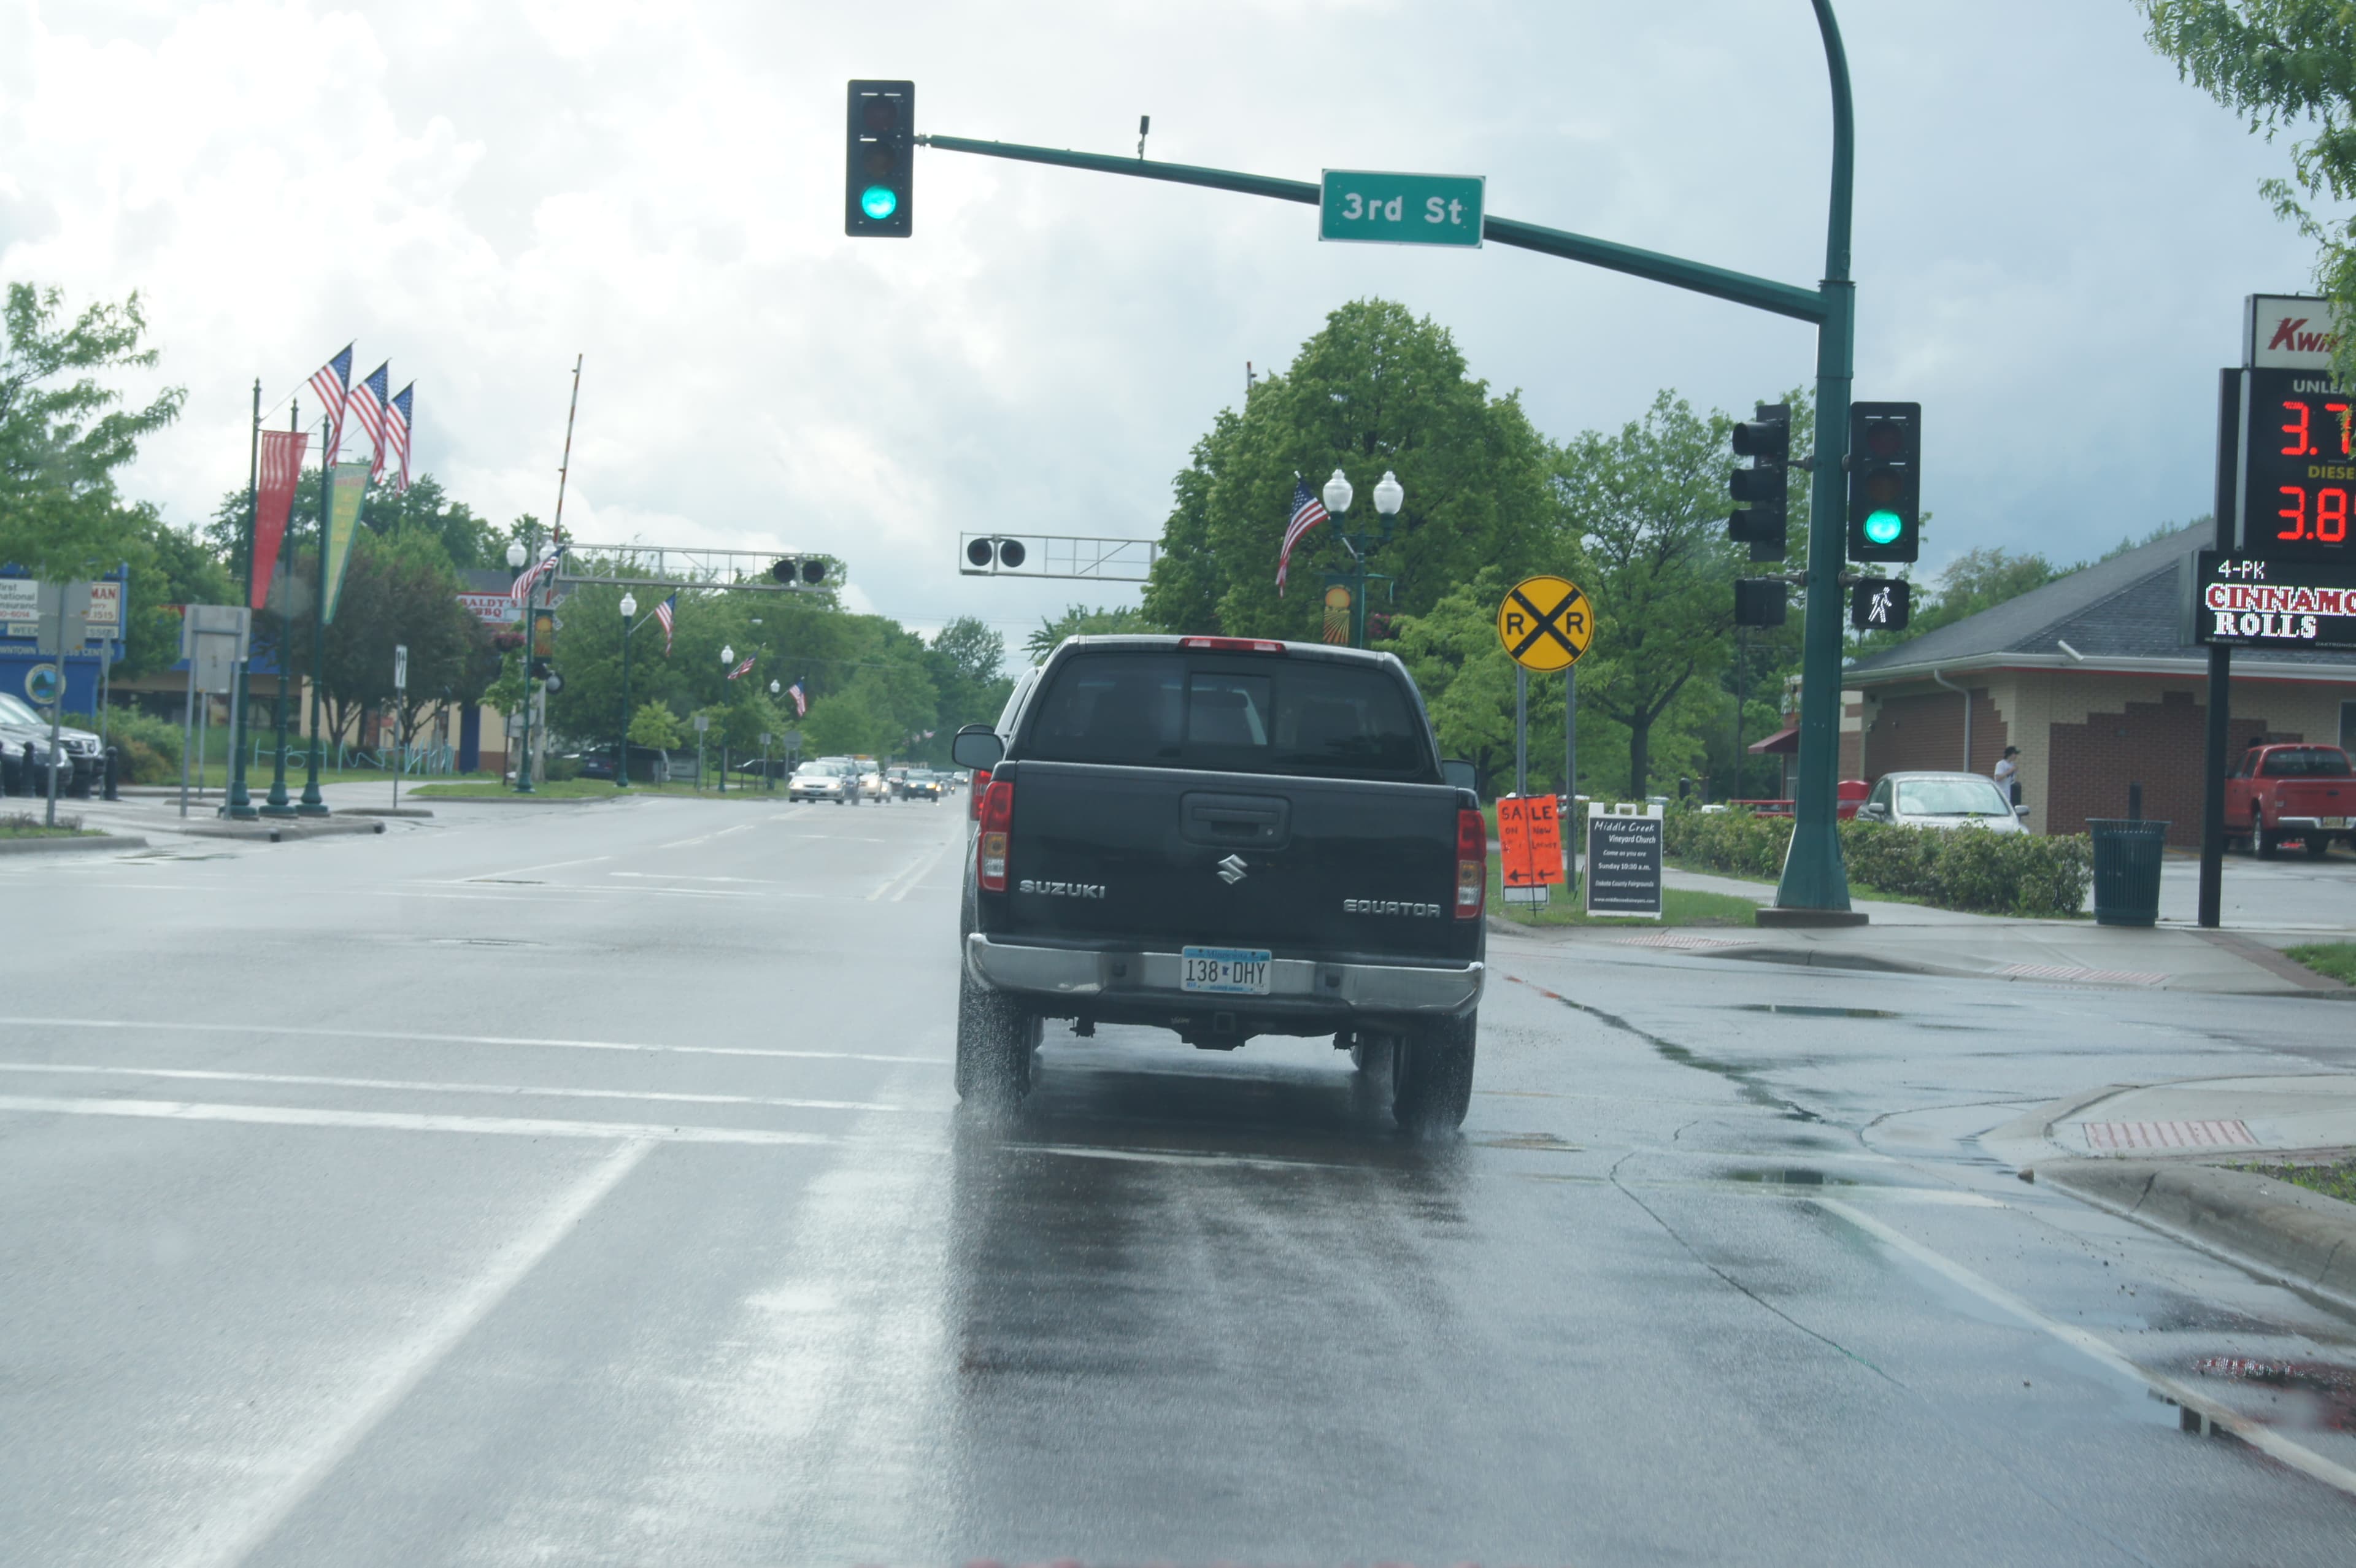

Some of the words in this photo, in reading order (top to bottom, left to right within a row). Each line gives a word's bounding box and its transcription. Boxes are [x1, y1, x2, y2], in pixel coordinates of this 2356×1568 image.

[1342, 193, 1403, 221] 3rd
[1424, 196, 1463, 225] St
[2277, 486, 2356, 542] 3.8
[2218, 559, 2266, 580] 4-PK
[2214, 612, 2317, 639] ROLLS
[1501, 805, 1553, 820] SALE
[1594, 821, 1626, 831] Middle
[1628, 822, 1655, 832] Creek
[1609, 834, 1635, 844] Vineyard
[1636, 835, 1656, 844] Church
[1598, 862, 1620, 870] Sunday
[1019, 879, 1106, 899] SUZUKI
[1344, 899, 1441, 918] EQUATOR
[1186, 959, 1218, 982] 138
[1233, 961, 1265, 984] DHY
